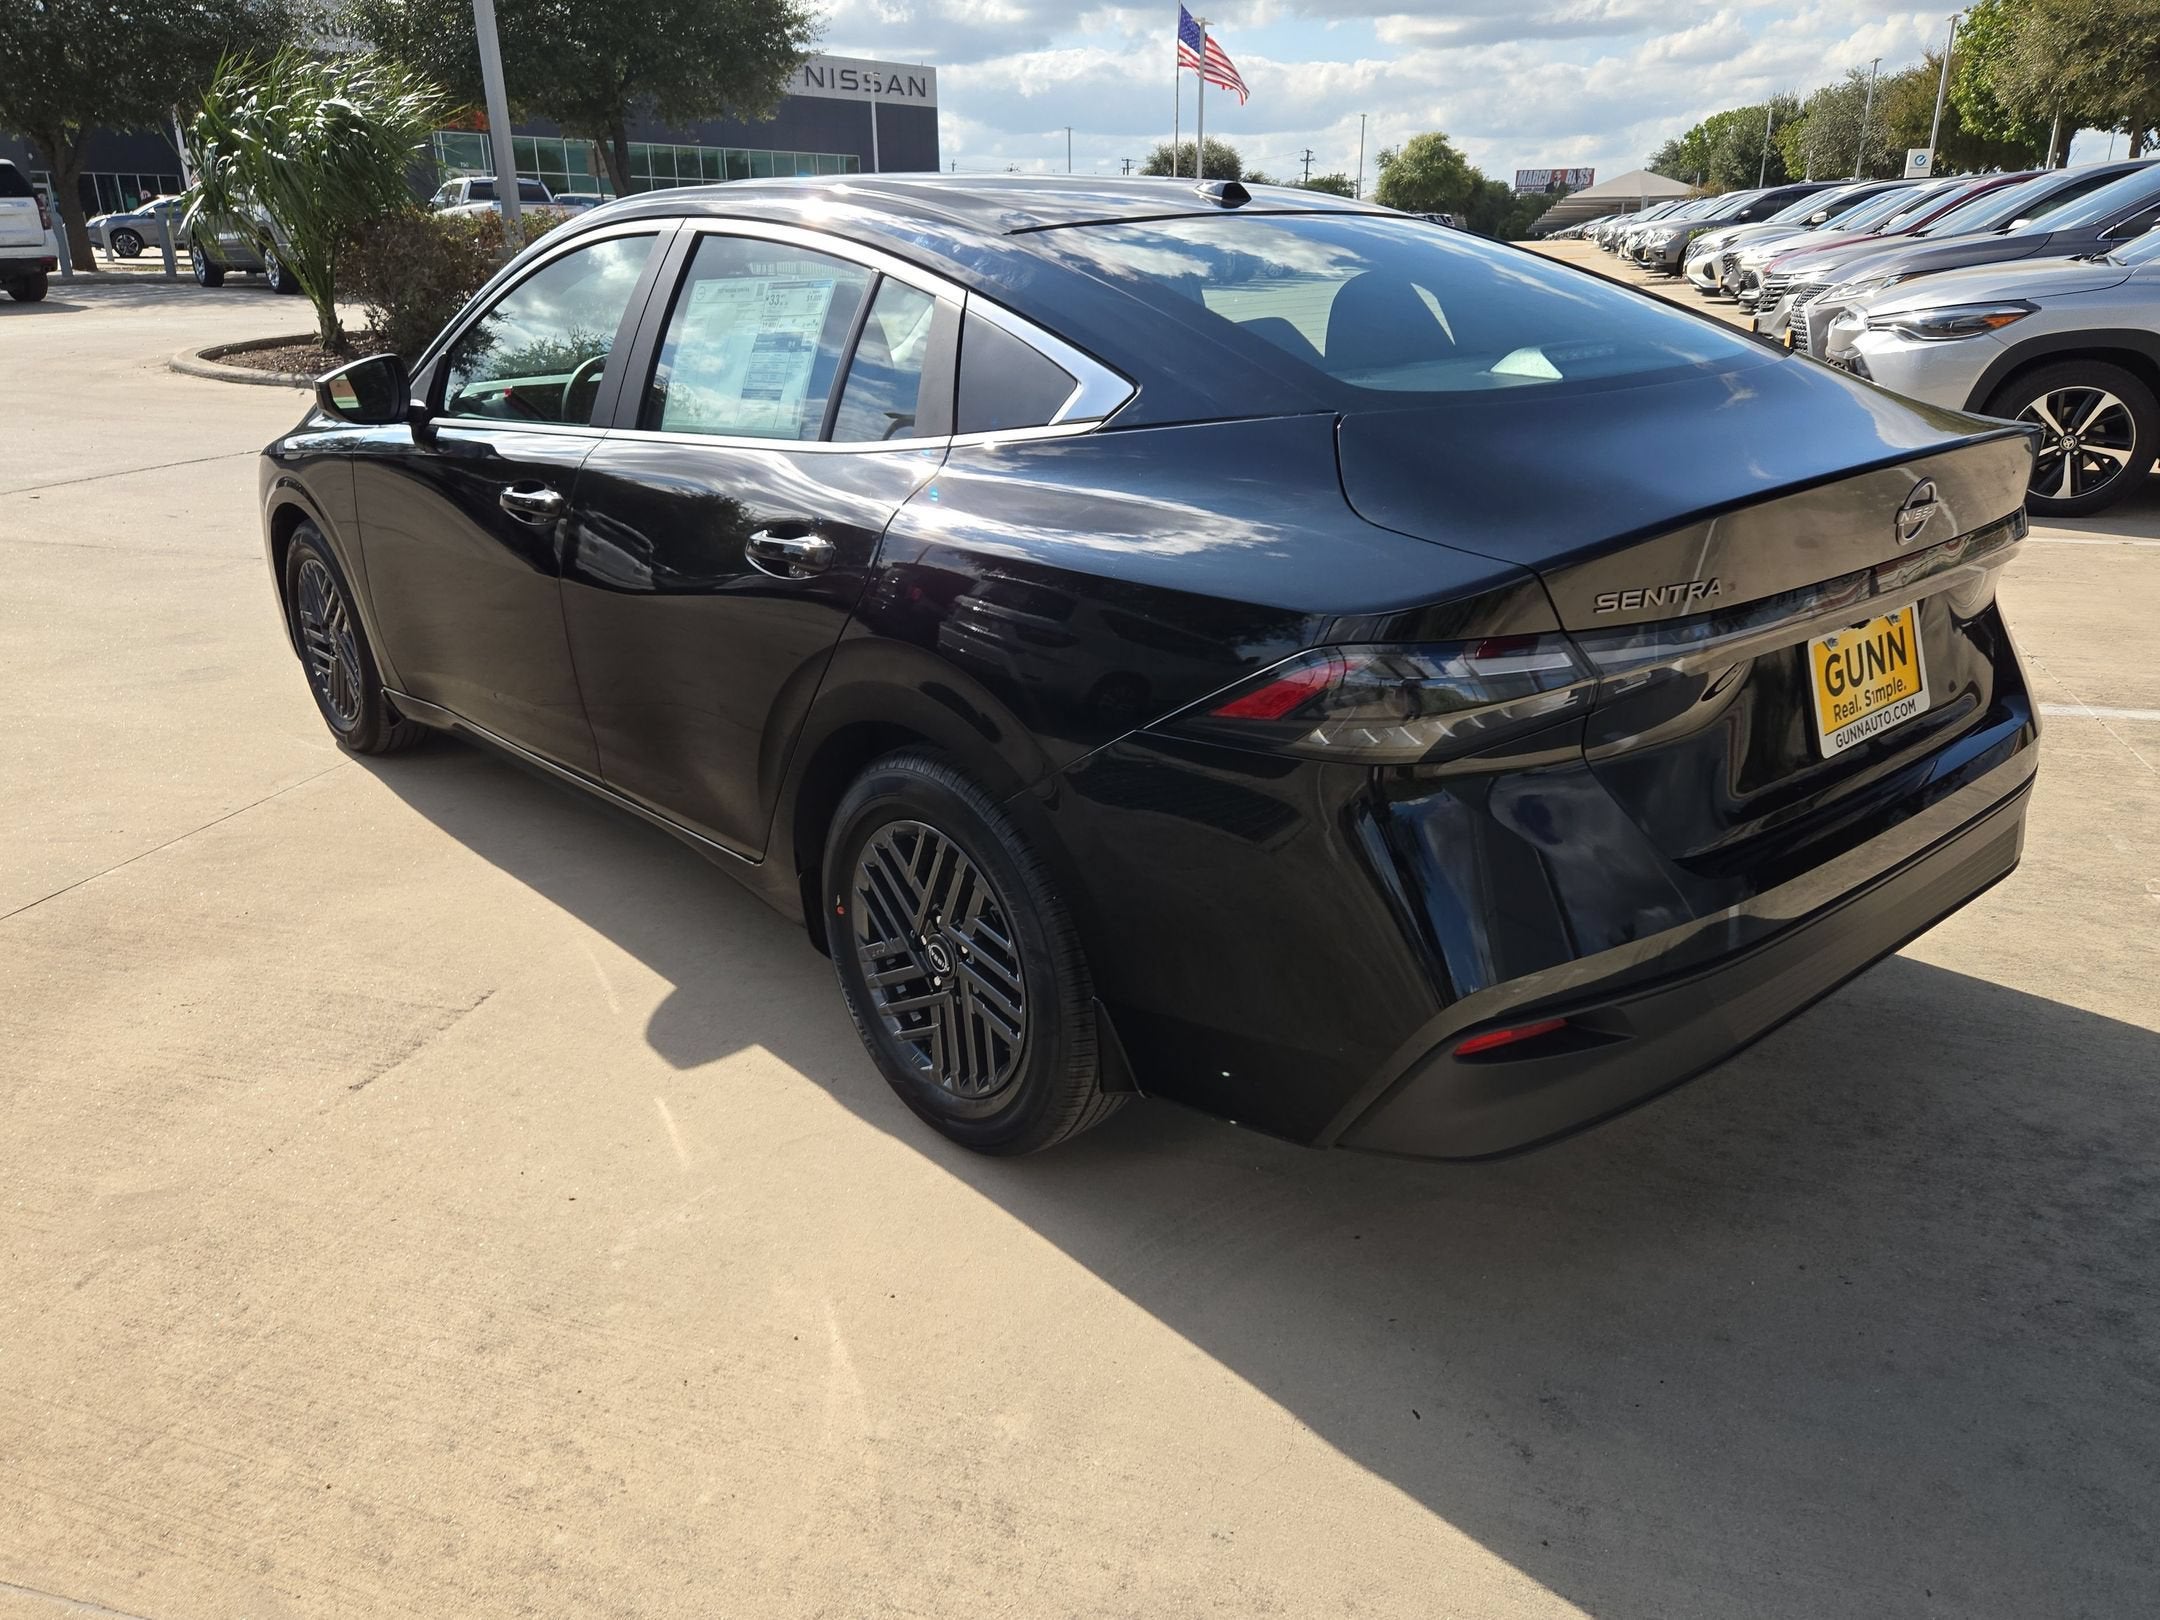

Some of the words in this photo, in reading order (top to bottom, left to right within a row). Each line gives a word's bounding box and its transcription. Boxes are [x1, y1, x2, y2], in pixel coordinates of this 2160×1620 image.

[804, 65, 927, 98] NISSAN
[1517, 170, 1553, 186] MARCO
[1593, 577, 1722, 614] SENTRA
[1824, 626, 1908, 697] GUNN
[1833, 694, 1862, 723] Real.
[1835, 699, 1917, 748] GUNNAUTO.COM
